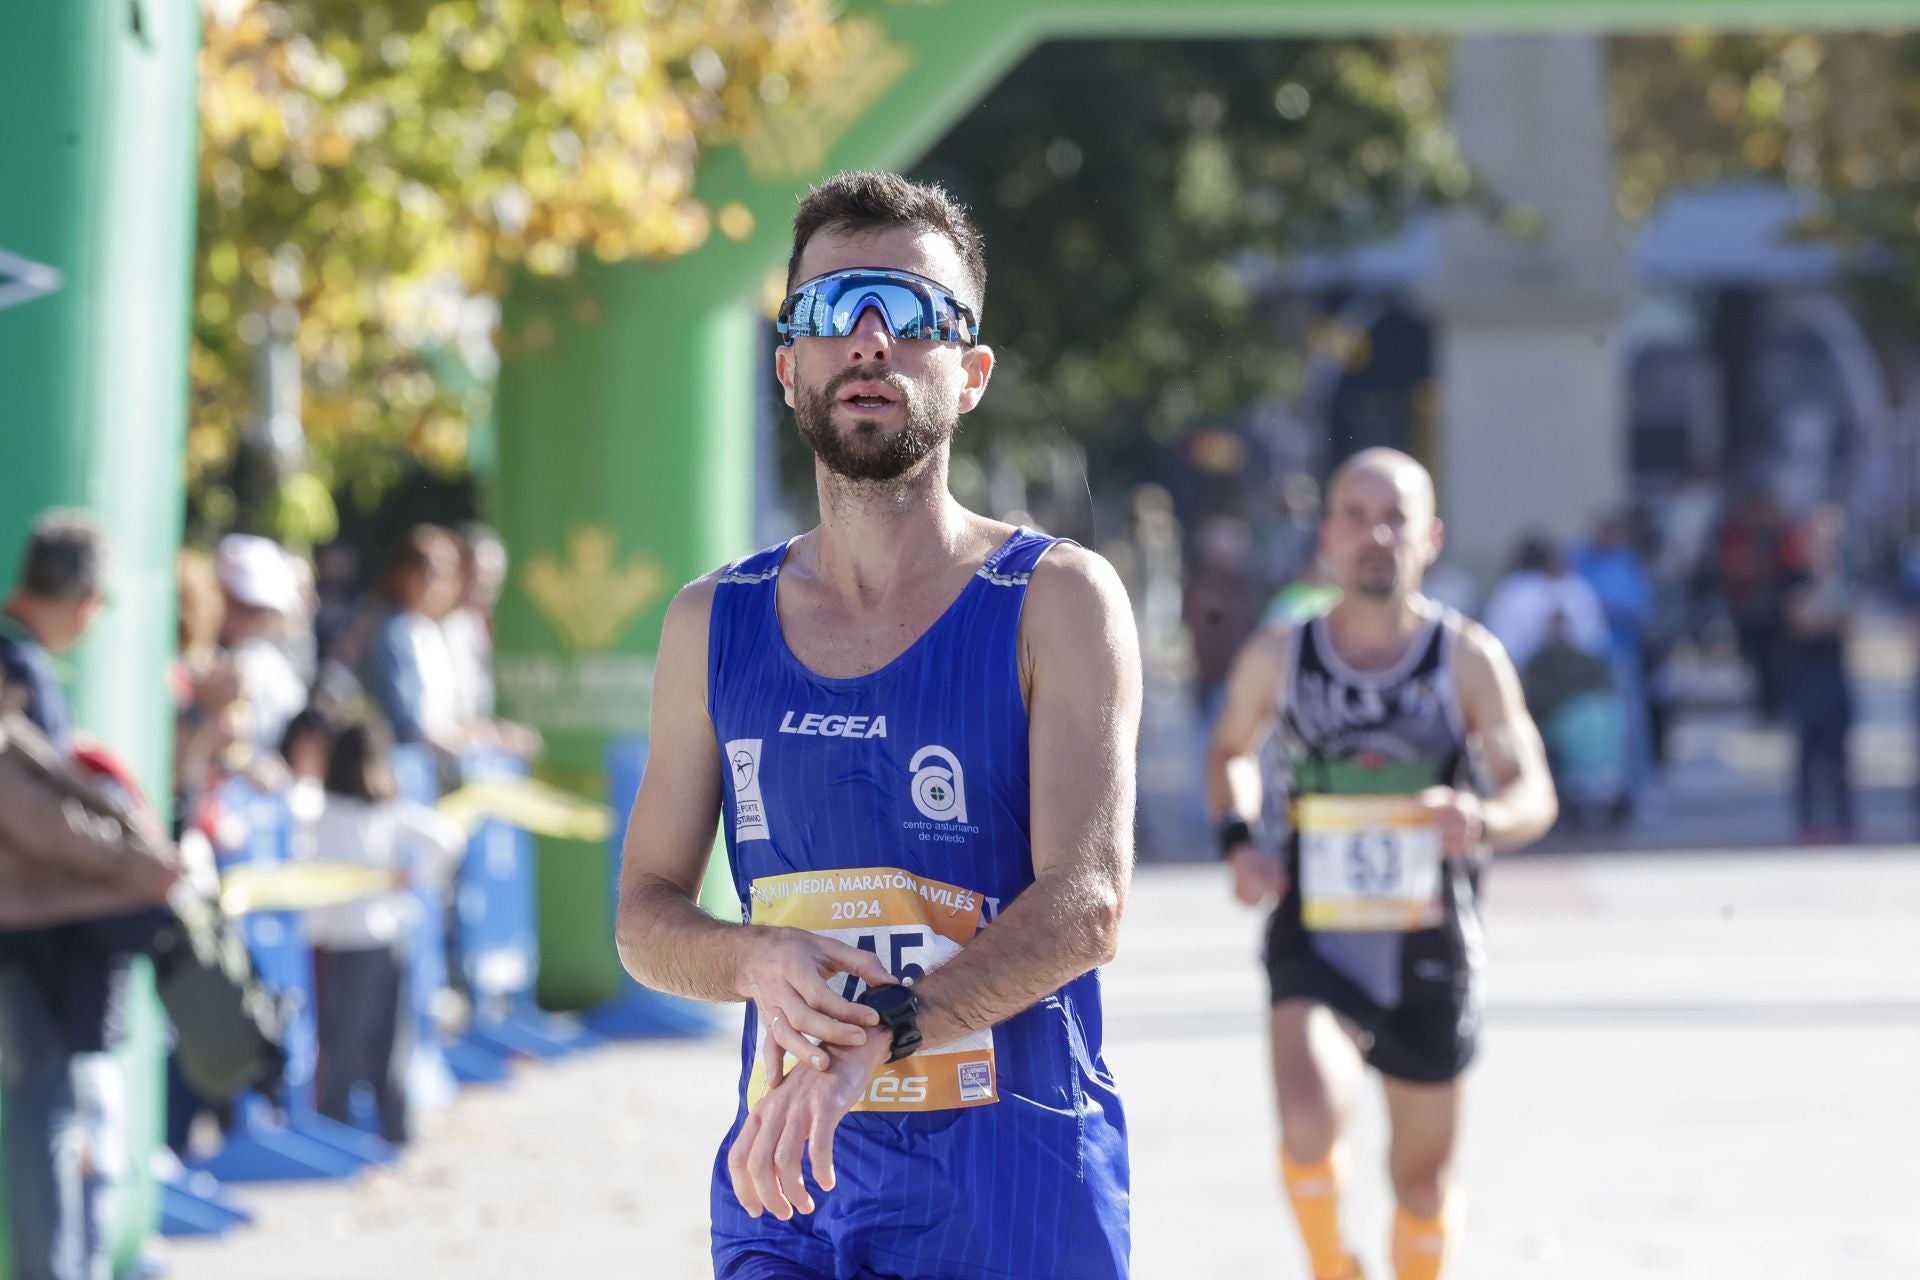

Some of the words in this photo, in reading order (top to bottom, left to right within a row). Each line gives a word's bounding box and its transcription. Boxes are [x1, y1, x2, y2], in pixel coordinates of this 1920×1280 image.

[778, 711, 887, 739] LEGEA
[903, 821, 933, 830] centro
[934, 822, 979, 834] asturiano
[918, 832, 931, 841] de
[933, 832, 965, 843] oviedo
[793, 878, 835, 896] MEDIA
[839, 871, 917, 892] MARATÓN
[920, 885, 976, 912] AVILÉS
[831, 900, 881, 920] 2024
